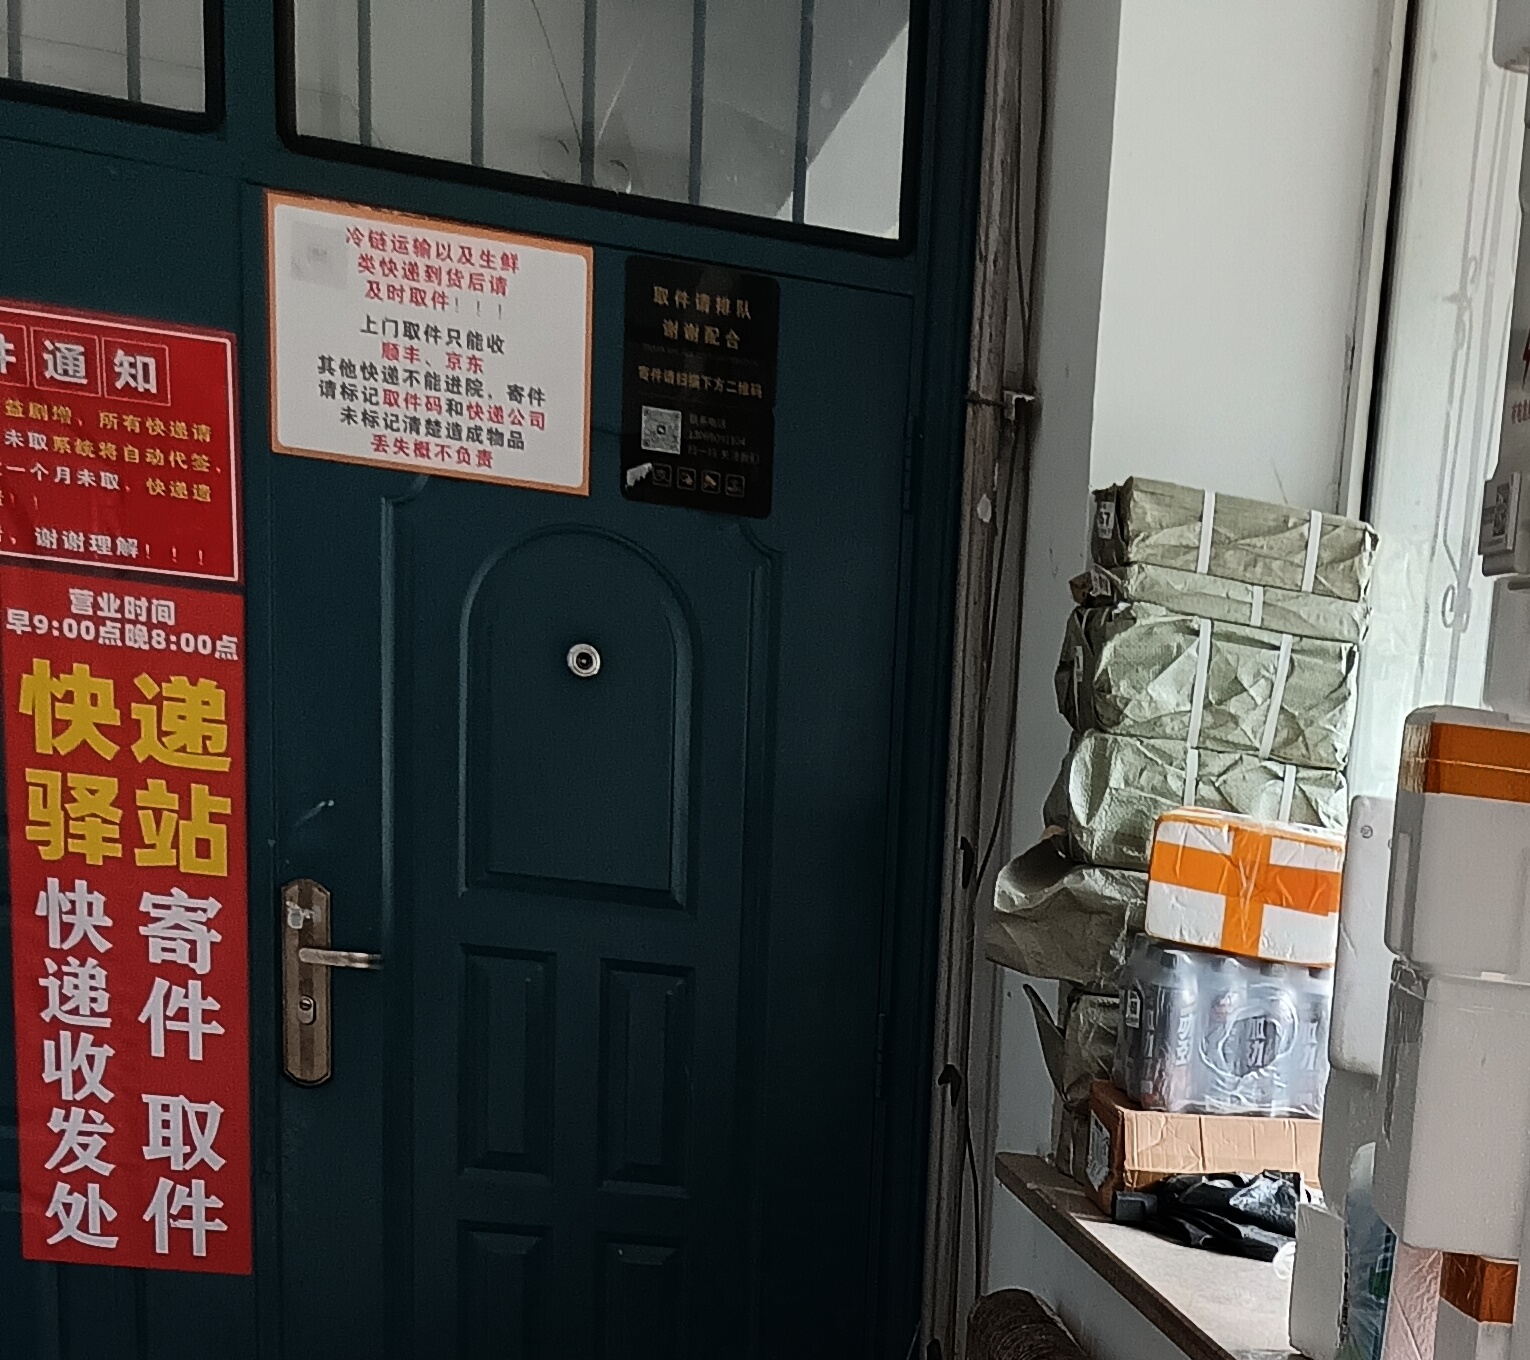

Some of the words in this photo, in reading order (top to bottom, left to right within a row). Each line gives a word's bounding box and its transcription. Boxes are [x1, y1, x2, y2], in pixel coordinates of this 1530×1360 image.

[346, 226, 520, 273] 冷链运输以及生鲜
[357, 253, 508, 297] 类快递到货后请
[653, 285, 751, 321] 取件请排队
[360, 315, 506, 355] 上门取件只能收
[662, 318, 740, 350] 谢谢配合
[318, 380, 546, 431] 请标记取件码和快递公司
[340, 406, 525, 451] 未标记清楚造成物品
[370, 434, 494, 469] 丢失概不负责
[68, 588, 176, 626] 营业时间
[6, 607, 239, 660] 早9:00点晚8:00点
[19, 657, 232, 772] 快递
[25, 767, 232, 876] 驿站
[138, 888, 226, 1062] 寄件
[35, 877, 119, 1250] 快递收发处
[141, 1093, 229, 1257] 取件
